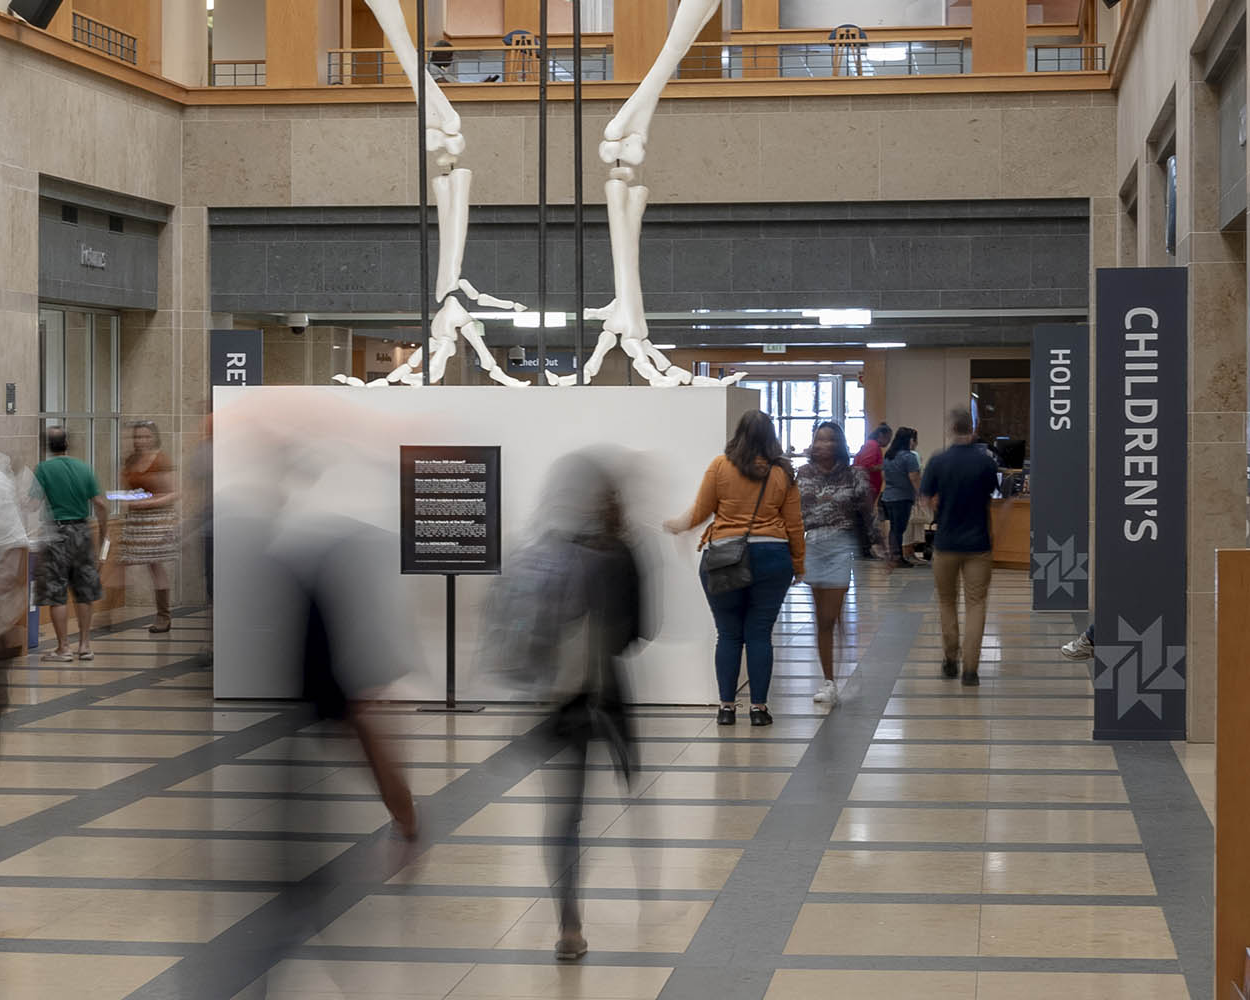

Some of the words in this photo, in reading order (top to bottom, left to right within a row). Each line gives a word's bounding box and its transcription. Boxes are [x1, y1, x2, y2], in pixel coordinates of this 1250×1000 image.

[226, 353, 246, 386] RE
[1050, 350, 1070, 430] HOLDS
[1124, 307, 1158, 541] CHILDREN'S
